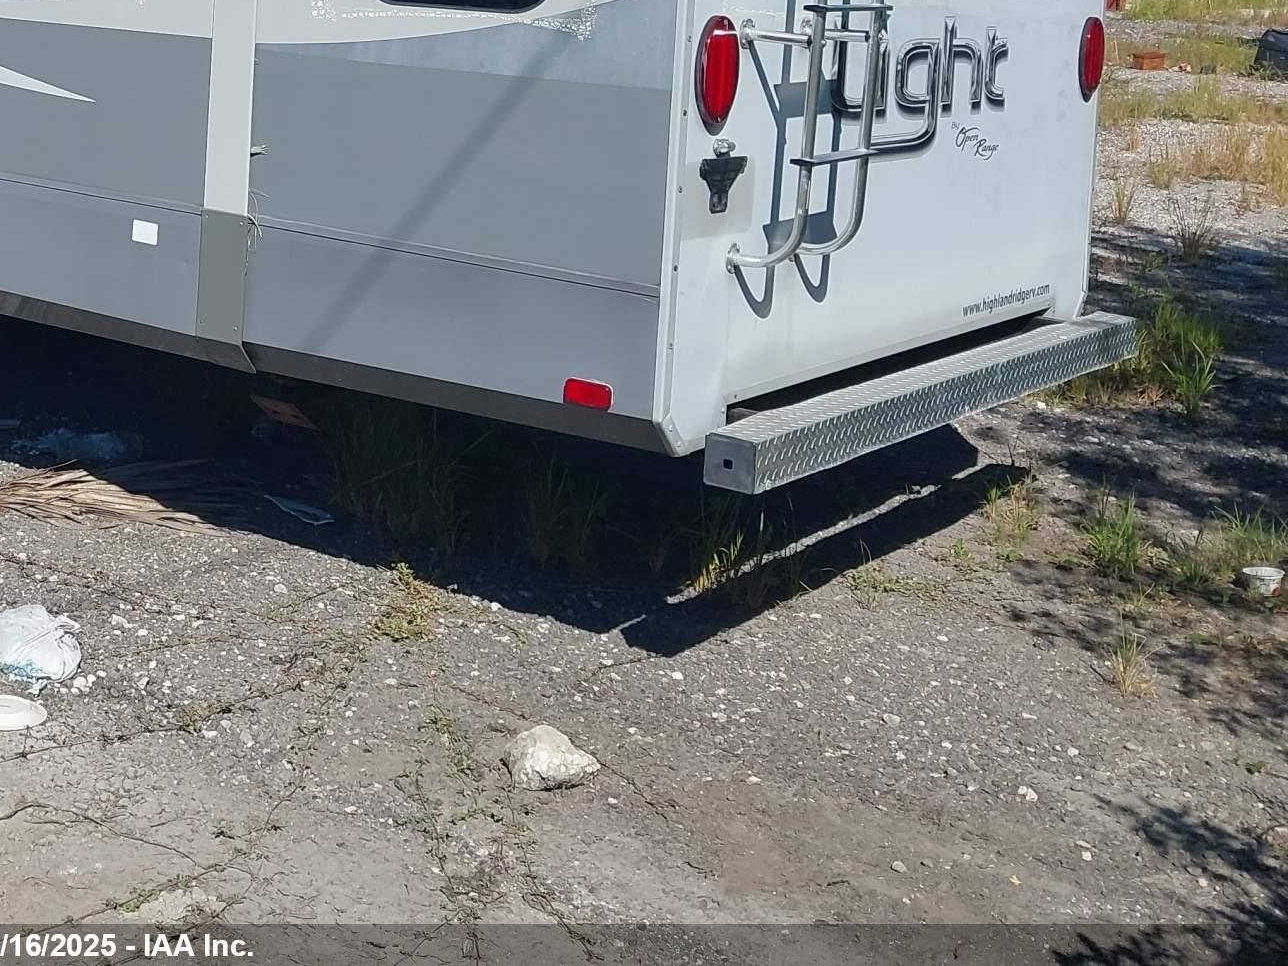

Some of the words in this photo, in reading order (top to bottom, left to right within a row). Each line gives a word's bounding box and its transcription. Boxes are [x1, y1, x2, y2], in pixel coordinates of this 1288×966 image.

[831, 16, 1008, 153] Light
[955, 126, 981, 152] Open
[973, 138, 1000, 161] Range
[962, 283, 1050, 317] www.highlandridgerv.com
